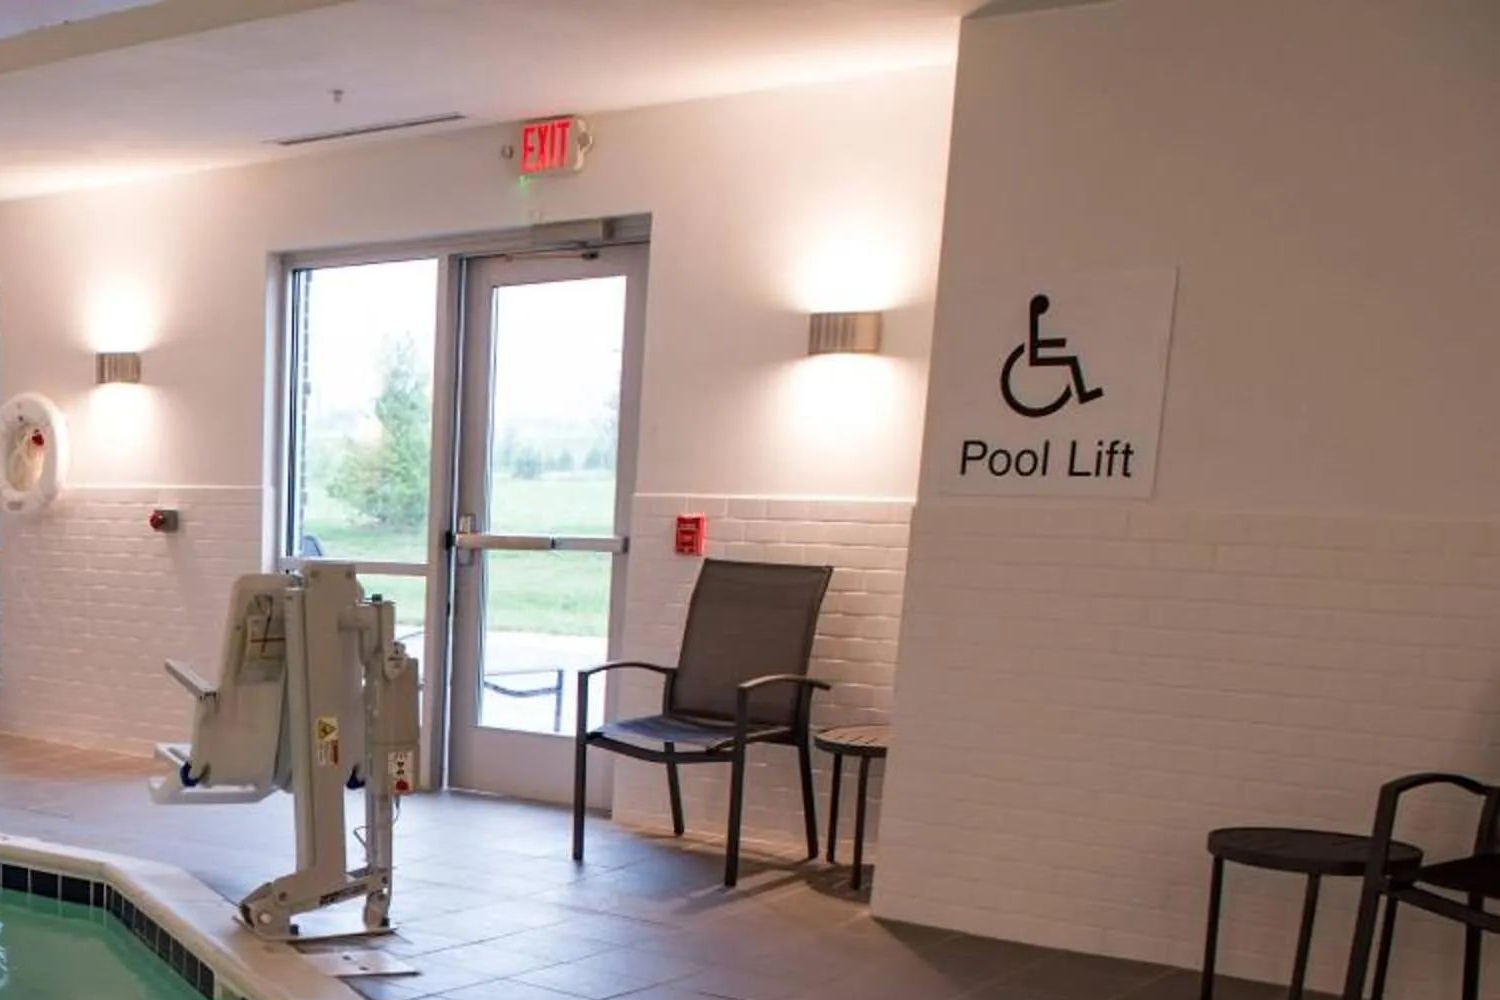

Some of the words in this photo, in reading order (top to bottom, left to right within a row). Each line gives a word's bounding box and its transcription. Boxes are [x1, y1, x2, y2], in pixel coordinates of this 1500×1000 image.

[520, 121, 571, 173] EXIT
[959, 440, 1050, 477] Pool
[1067, 440, 1134, 478] Lift
